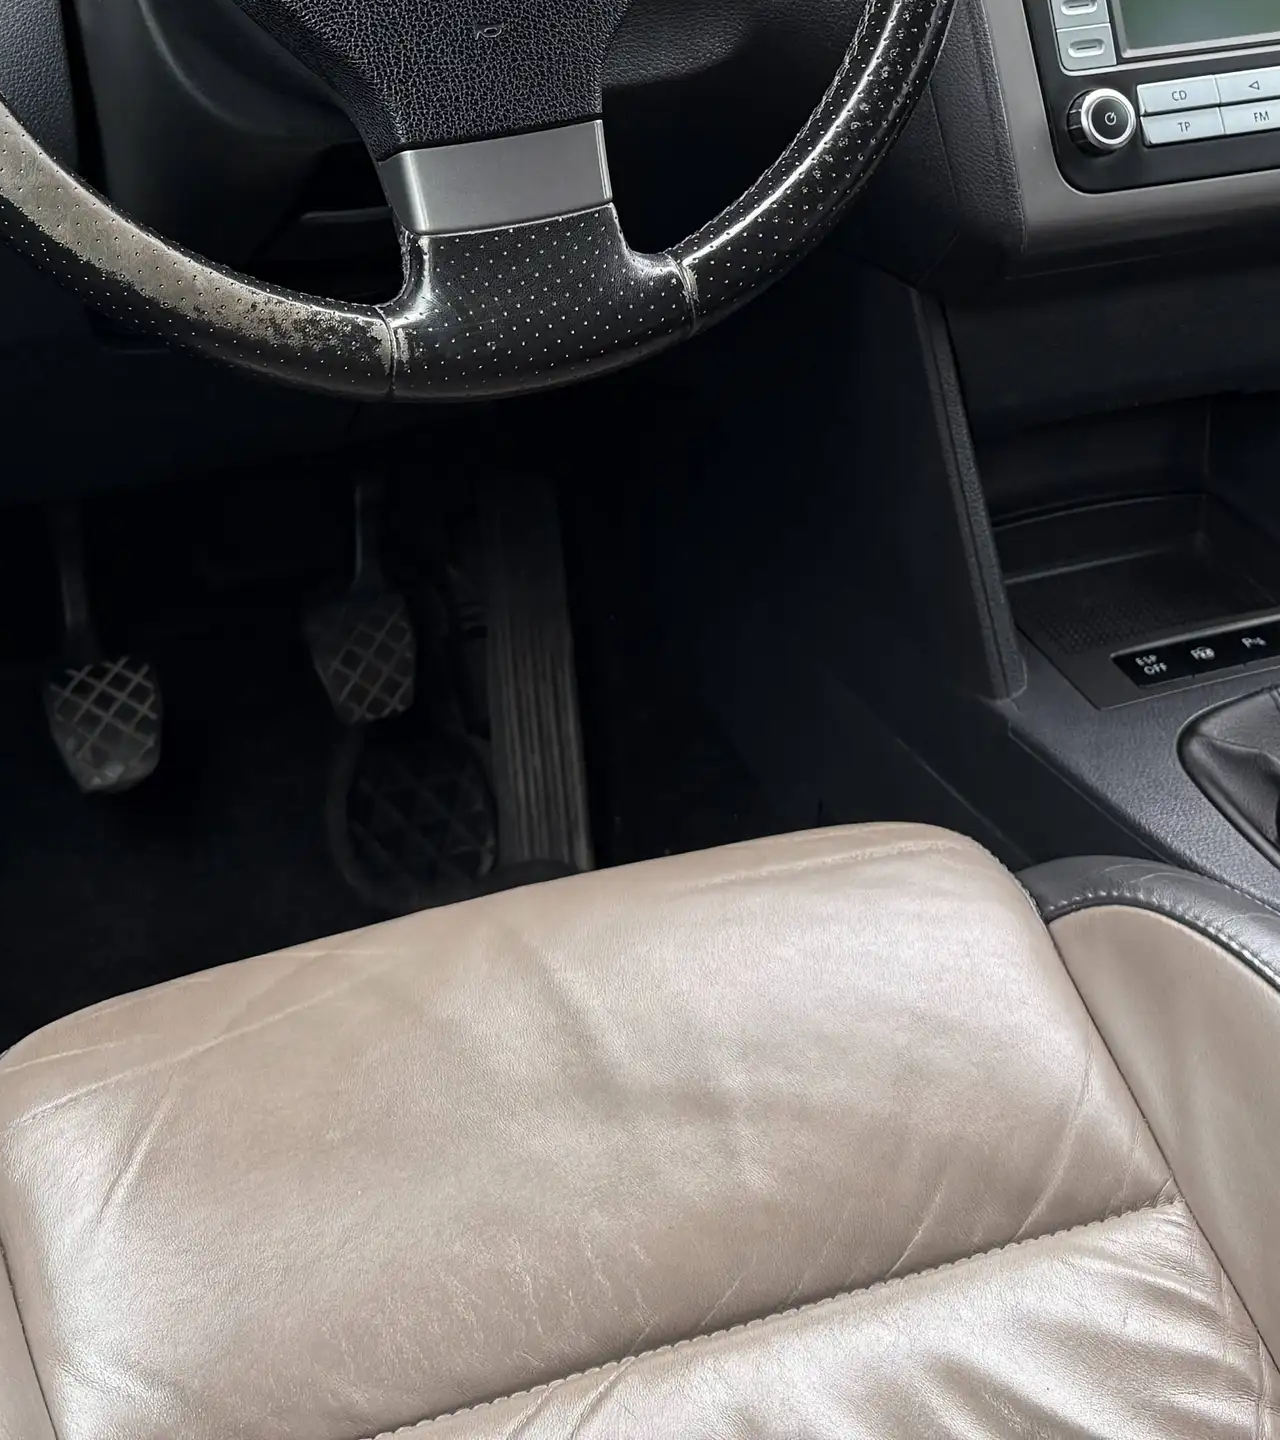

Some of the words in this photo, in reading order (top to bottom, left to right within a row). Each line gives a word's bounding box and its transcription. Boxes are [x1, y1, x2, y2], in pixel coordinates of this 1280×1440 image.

[1171, 89, 1187, 101] CD
[1253, 110, 1270, 123] FM
[1177, 121, 1192, 133] TP
[1144, 662, 1168, 676] OFF
